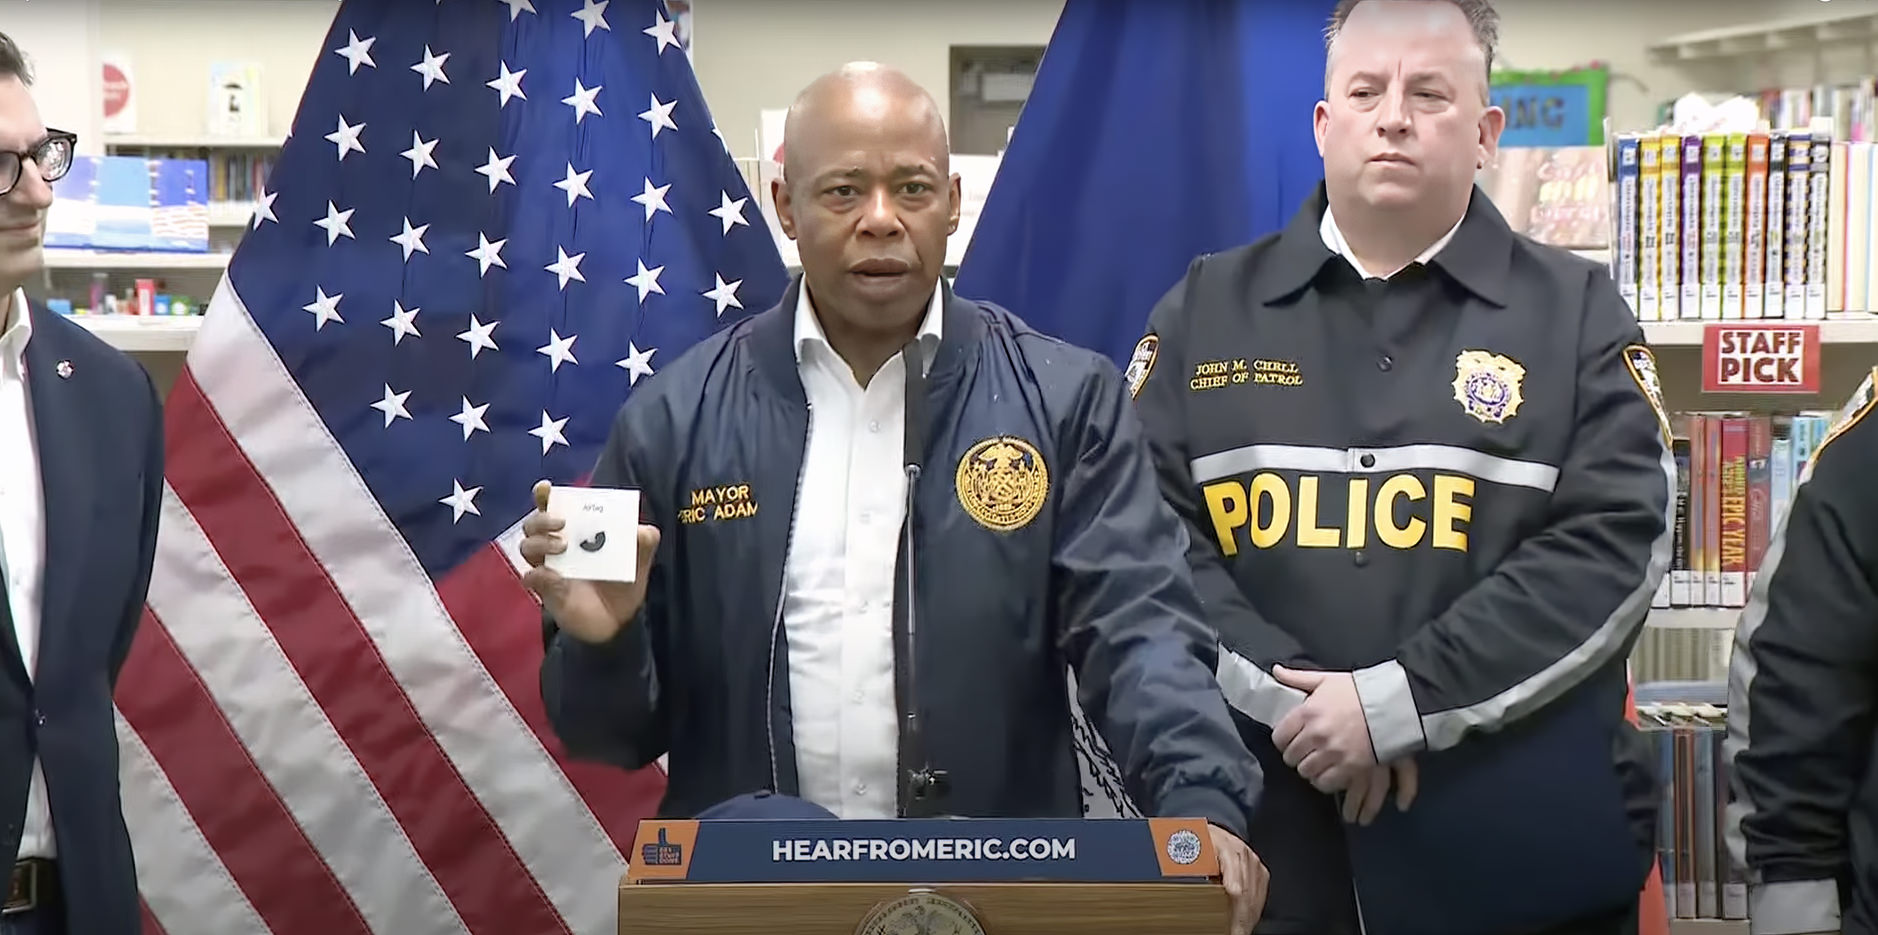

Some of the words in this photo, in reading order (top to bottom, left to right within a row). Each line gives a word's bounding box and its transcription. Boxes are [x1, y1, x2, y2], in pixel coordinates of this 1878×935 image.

[1721, 331, 1800, 354] STAFF
[1196, 361, 1229, 376] JOHN
[1231, 359, 1248, 372] M.
[1721, 357, 1799, 383] PICK
[1189, 376, 1228, 391] CHIEF
[1232, 373, 1249, 384] OF
[1253, 373, 1303, 387] PATROL
[691, 485, 749, 506] MAYOR
[1203, 472, 1475, 557] POLICE
[1721, 528, 1745, 566] YEAR
[772, 838, 1076, 861] HEARFROMERIC.COM
